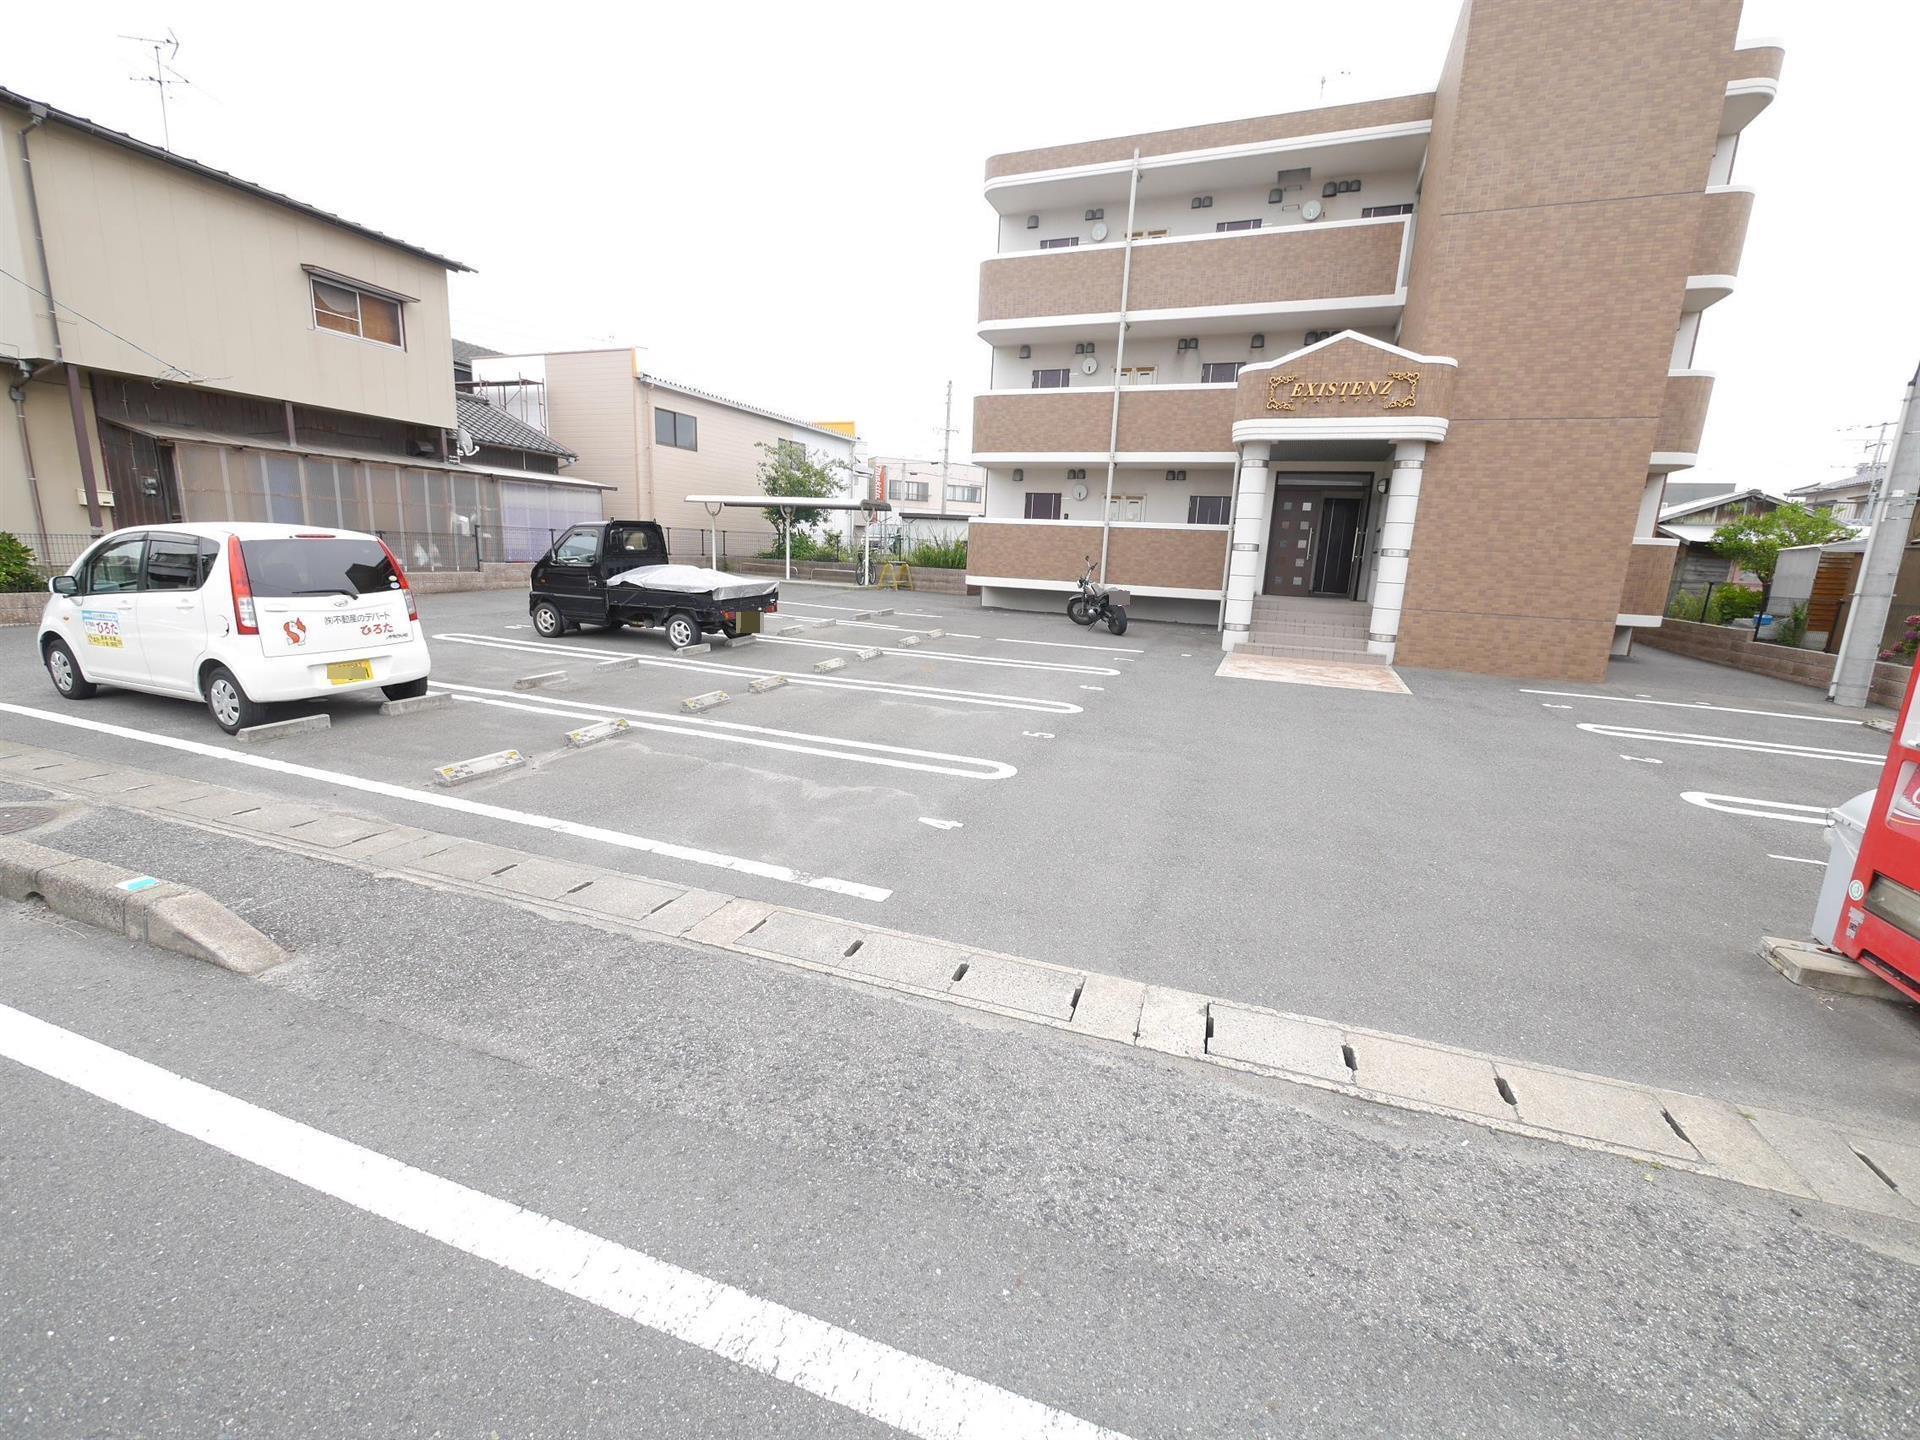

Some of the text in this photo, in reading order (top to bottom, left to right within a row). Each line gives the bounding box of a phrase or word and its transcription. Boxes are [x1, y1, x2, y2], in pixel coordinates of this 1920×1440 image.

[1290, 380, 1394, 397] EXISTENZ
[96, 621, 119, 635] ひろた
[360, 622, 394, 635] ひろた
